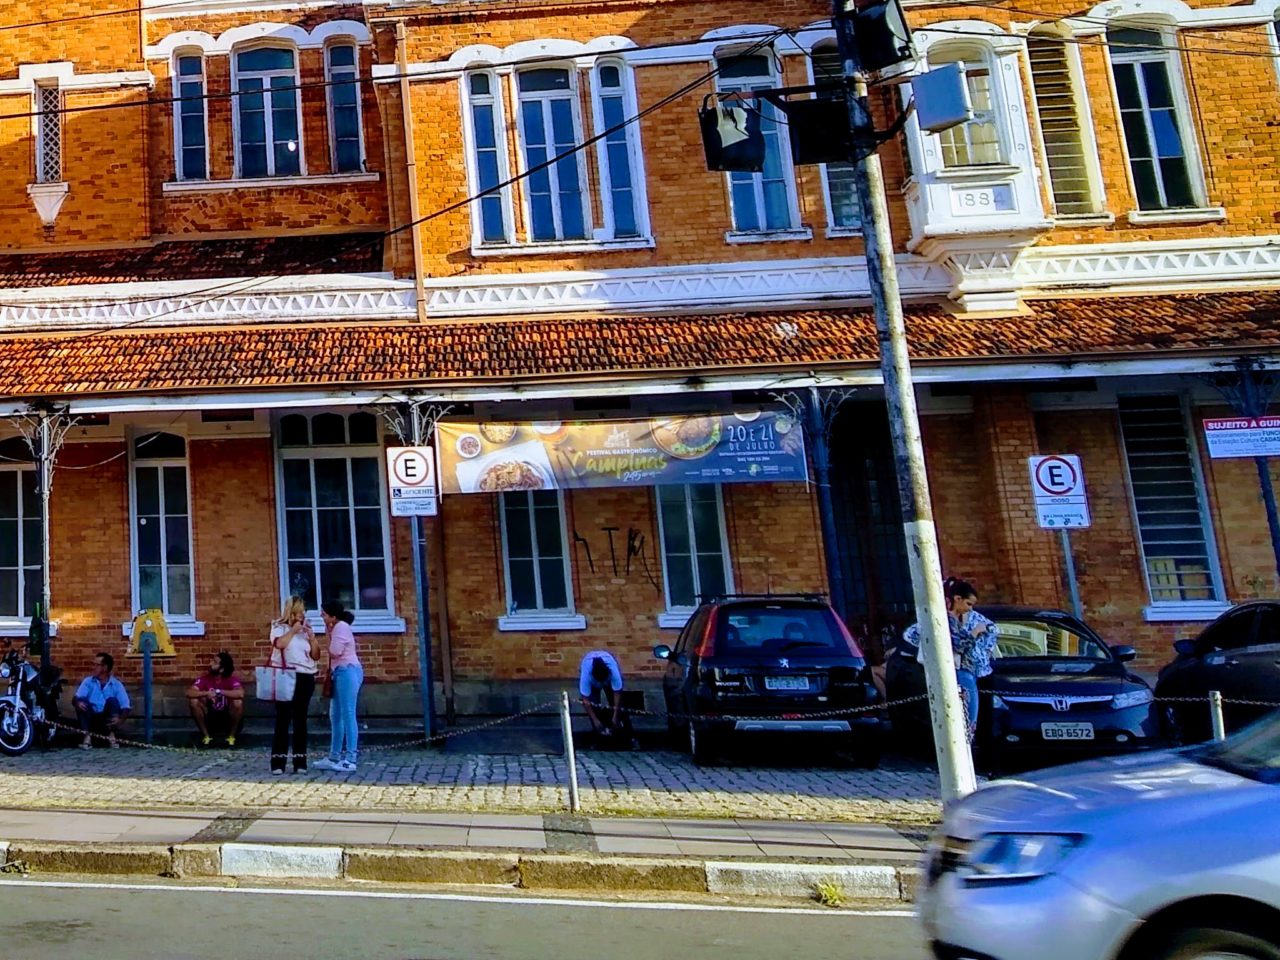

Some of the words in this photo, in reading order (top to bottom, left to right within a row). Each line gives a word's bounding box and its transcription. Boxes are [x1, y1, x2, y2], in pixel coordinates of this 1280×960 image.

[727, 424, 747, 442] 20
[749, 428, 756, 441] E
[759, 423, 774, 441] 21
[1207, 421, 1249, 430] SUJEITO
[728, 442, 740, 451] DE
[404, 458, 417, 478] E
[570, 451, 668, 480] Campinas
[1048, 465, 1065, 487] E
